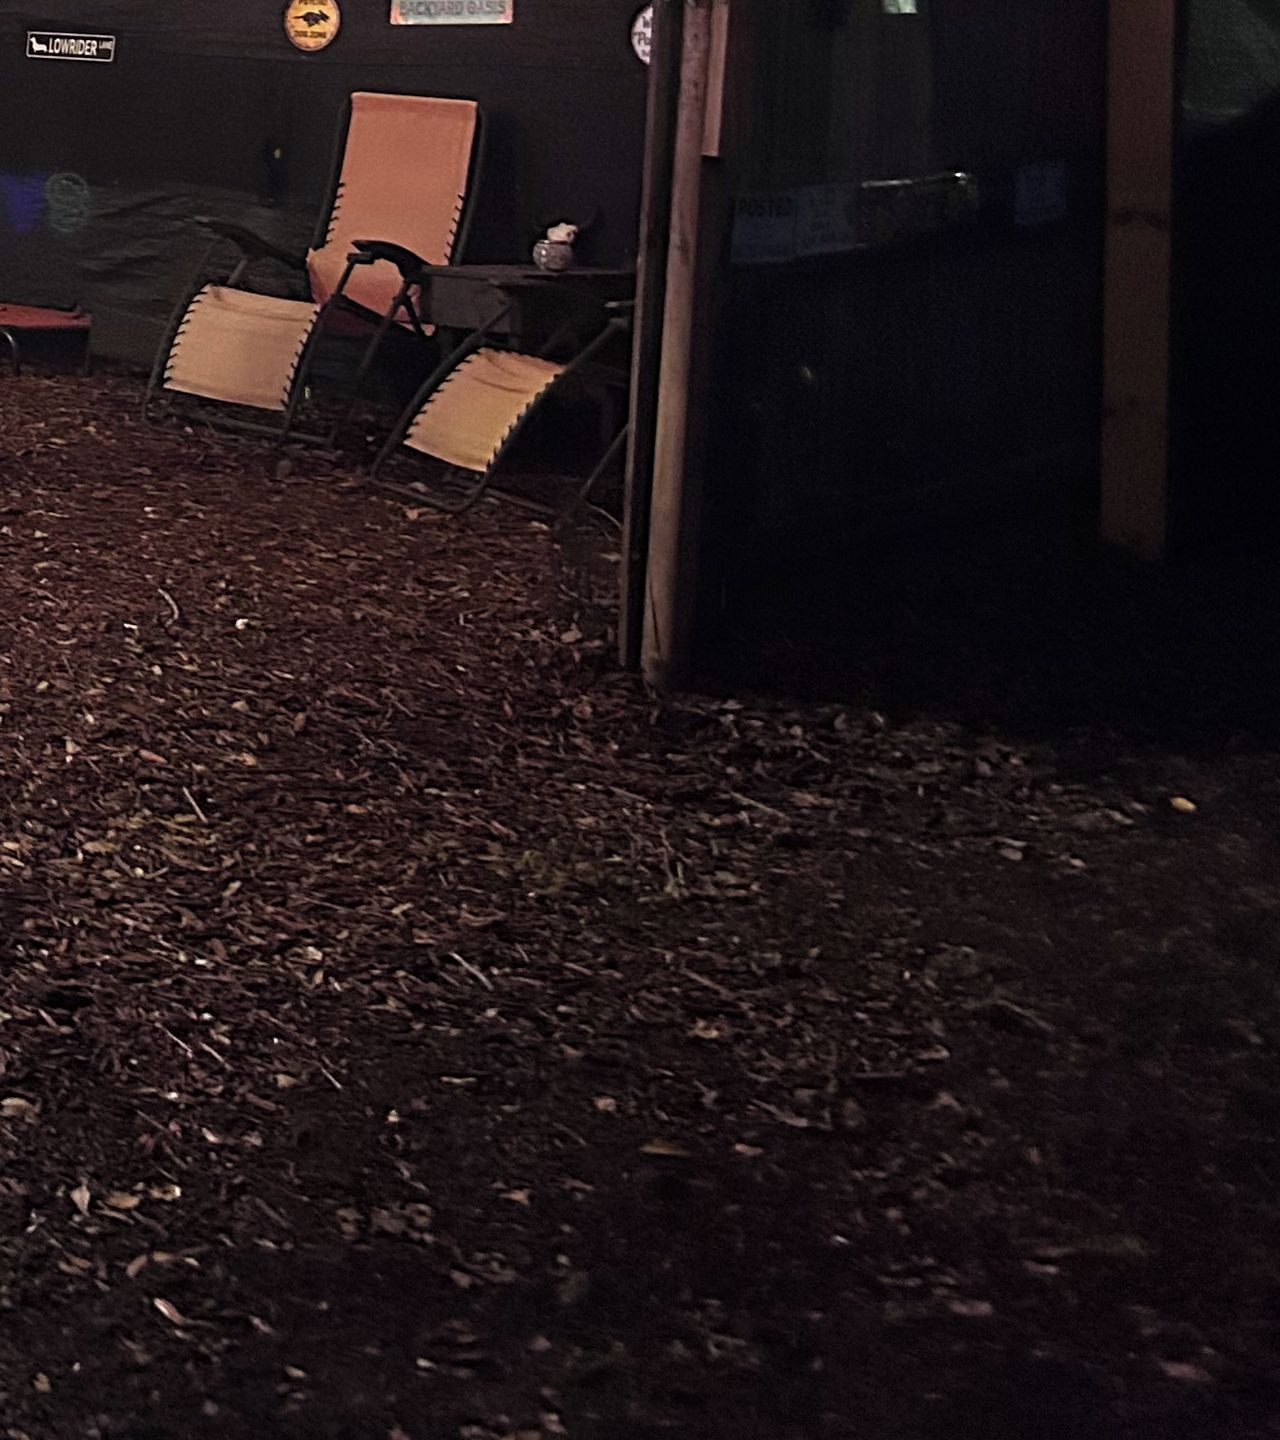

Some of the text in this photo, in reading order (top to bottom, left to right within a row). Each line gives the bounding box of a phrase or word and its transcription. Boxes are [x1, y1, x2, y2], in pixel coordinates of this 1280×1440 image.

[399, 0, 506, 16] BACKYARD OASIS
[48, 38, 113, 56] LOWRIDER LANE
